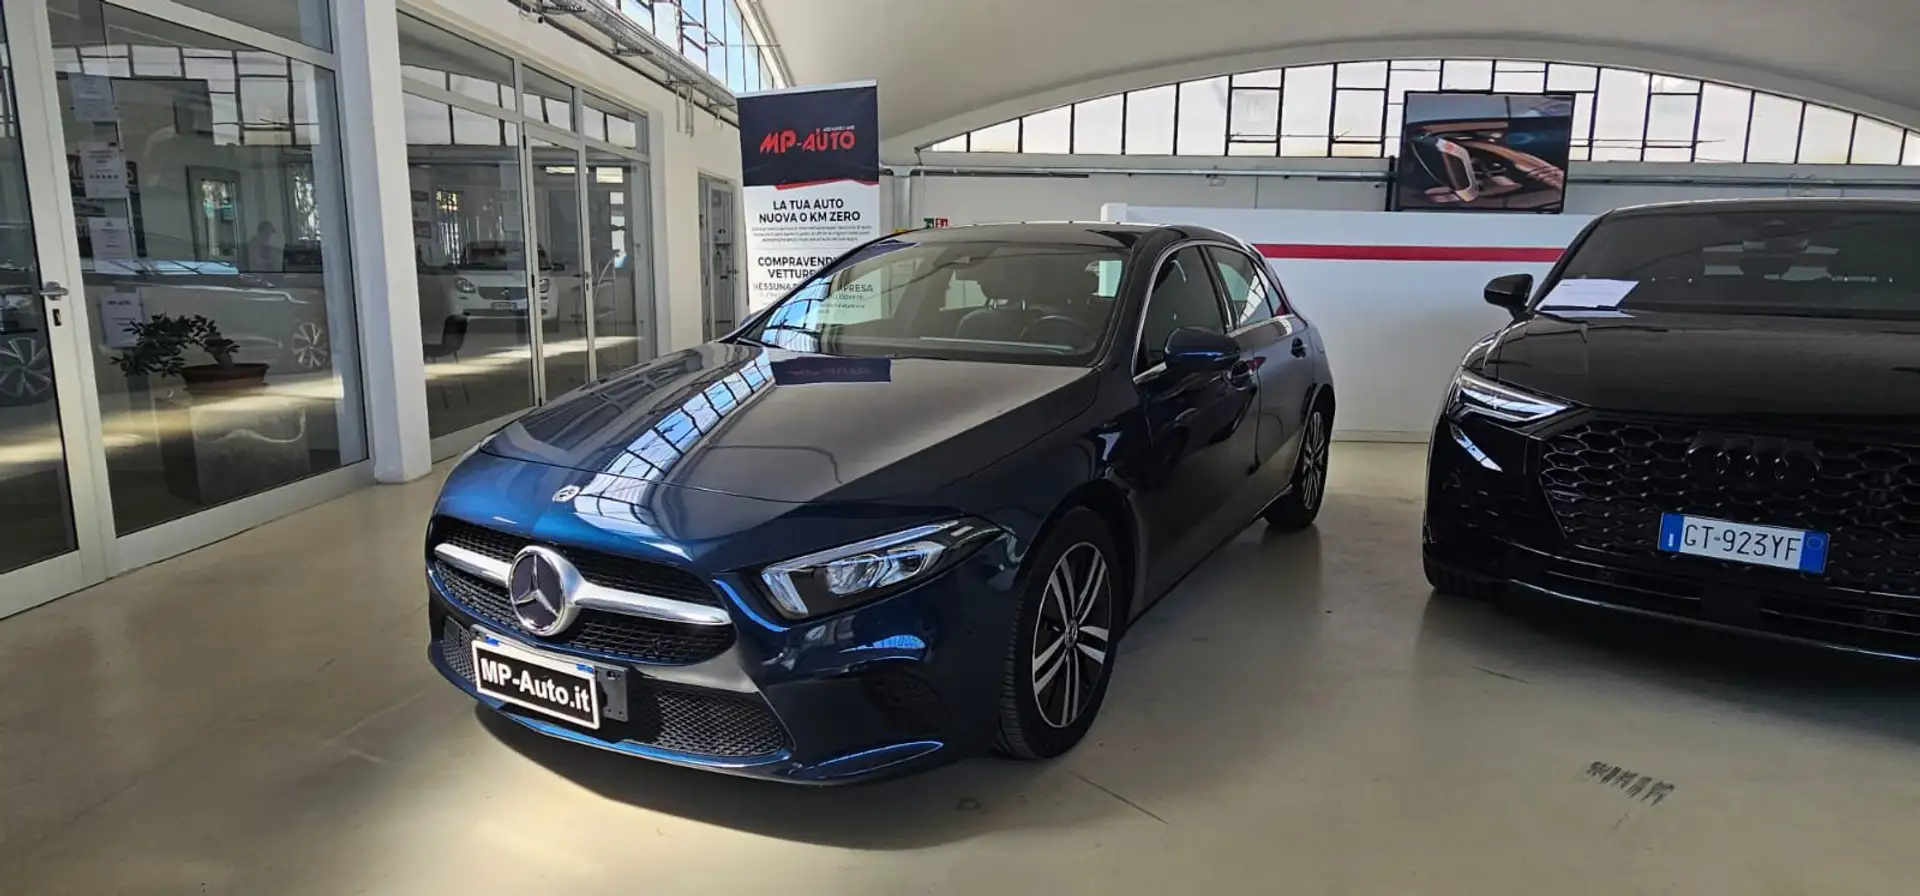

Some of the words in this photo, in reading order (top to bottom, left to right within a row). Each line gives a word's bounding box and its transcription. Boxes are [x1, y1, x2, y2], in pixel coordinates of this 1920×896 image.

[760, 128, 856, 154] MP-AUTO
[773, 200, 786, 210] LA
[790, 199, 811, 210] TUA
[813, 198, 844, 209] AUTO
[759, 213, 797, 223] NUOVA
[810, 211, 827, 222] KM
[829, 211, 861, 222] ZERO
[757, 256, 837, 267] COMPRAVEND
[479, 657, 591, 713] MP-Auto.it
